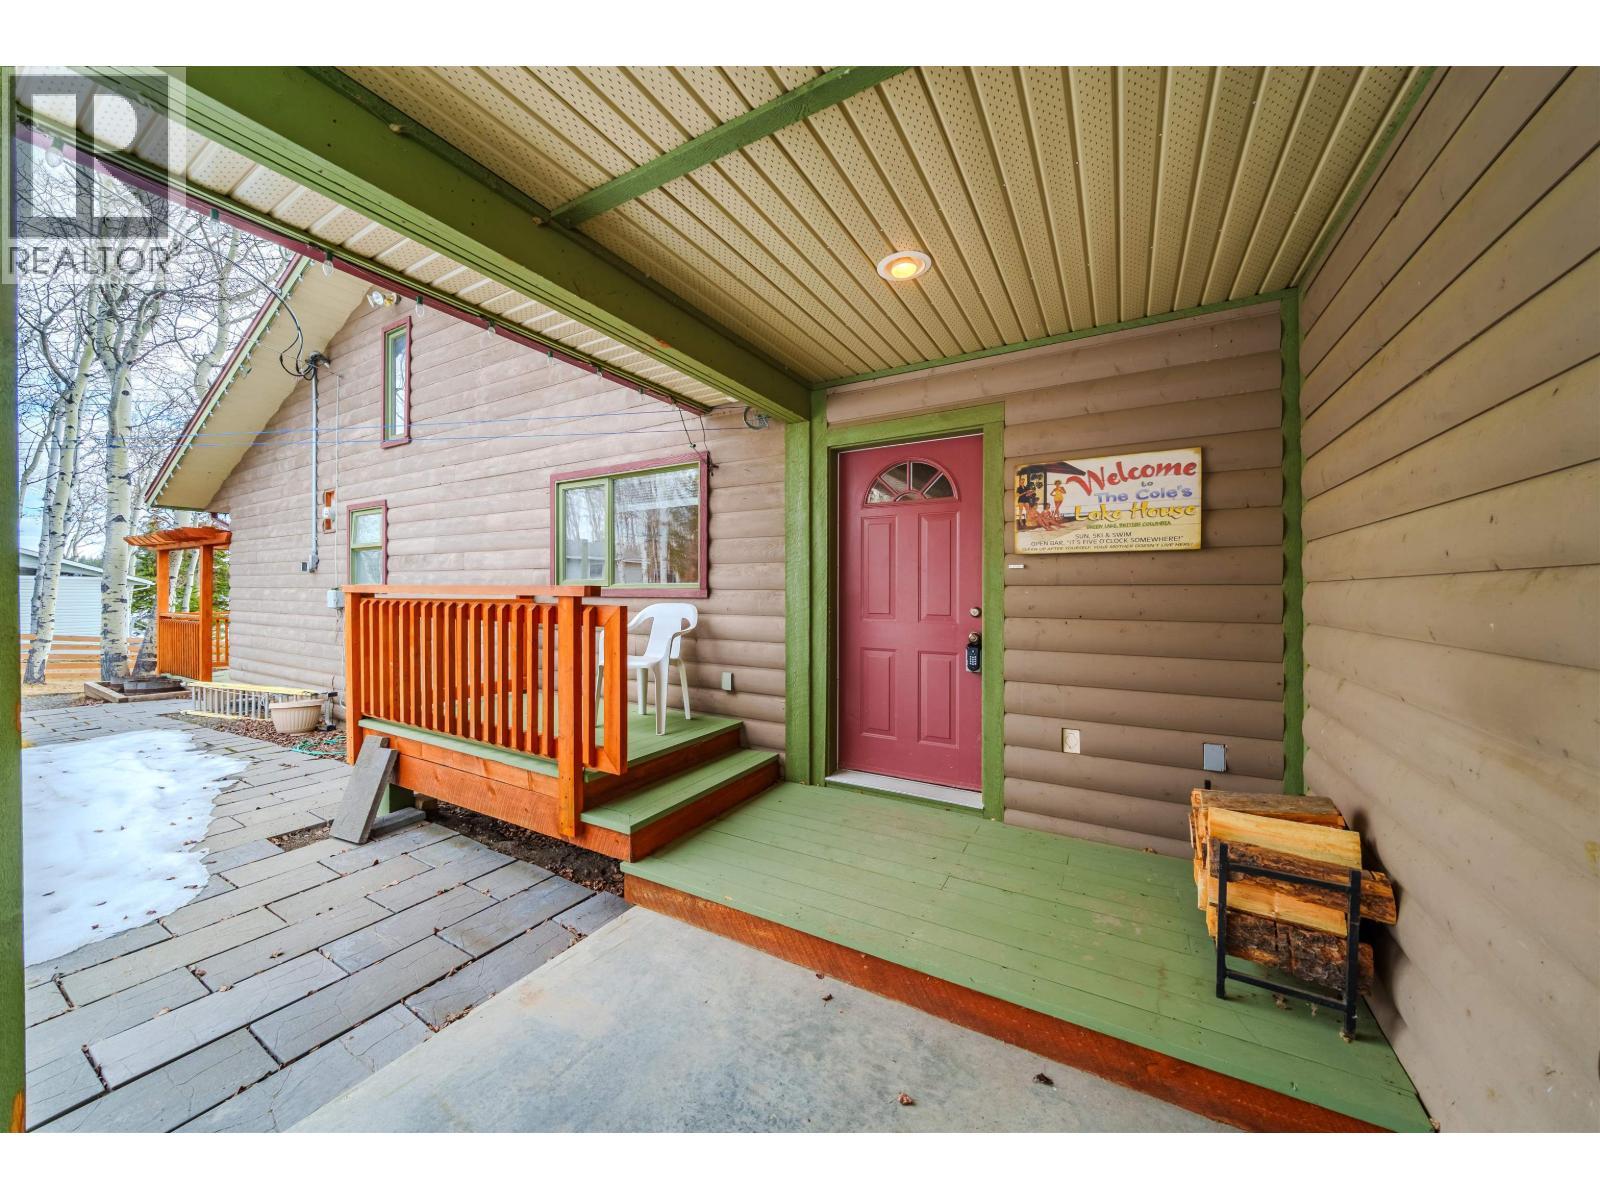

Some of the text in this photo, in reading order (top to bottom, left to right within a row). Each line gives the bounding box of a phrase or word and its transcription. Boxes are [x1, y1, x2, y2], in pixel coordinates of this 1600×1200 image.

[1066, 461, 1197, 496] Welcome
[1094, 486, 1193, 503] The Cole's
[1074, 501, 1196, 522] Lake House
